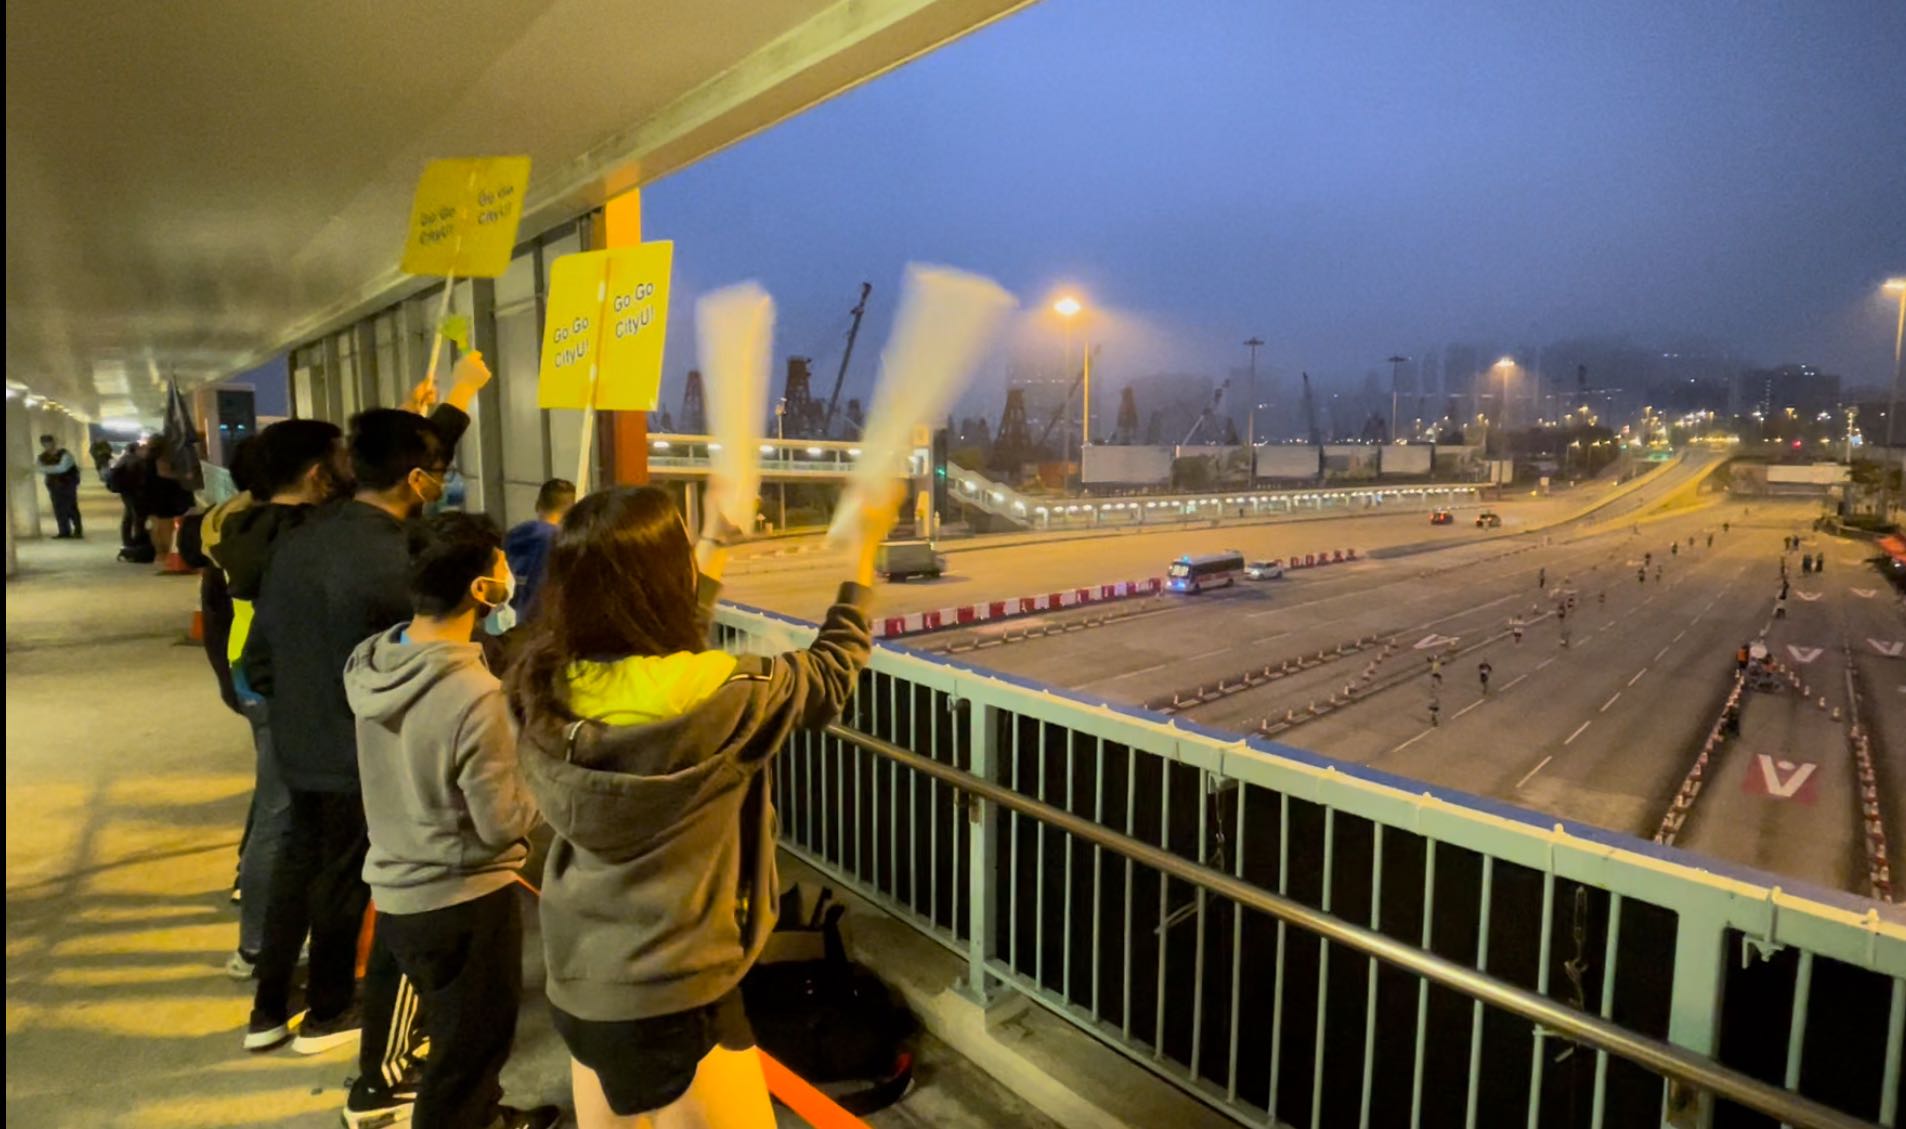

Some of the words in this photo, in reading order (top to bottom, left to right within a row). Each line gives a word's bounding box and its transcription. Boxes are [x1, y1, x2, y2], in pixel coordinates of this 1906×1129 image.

[614, 295, 631, 312] Go
[635, 283, 653, 300] Go
[553, 328, 569, 344] Go
[573, 317, 589, 333] Go
[615, 304, 654, 338] CityU!
[554, 338, 589, 368] CityU!
